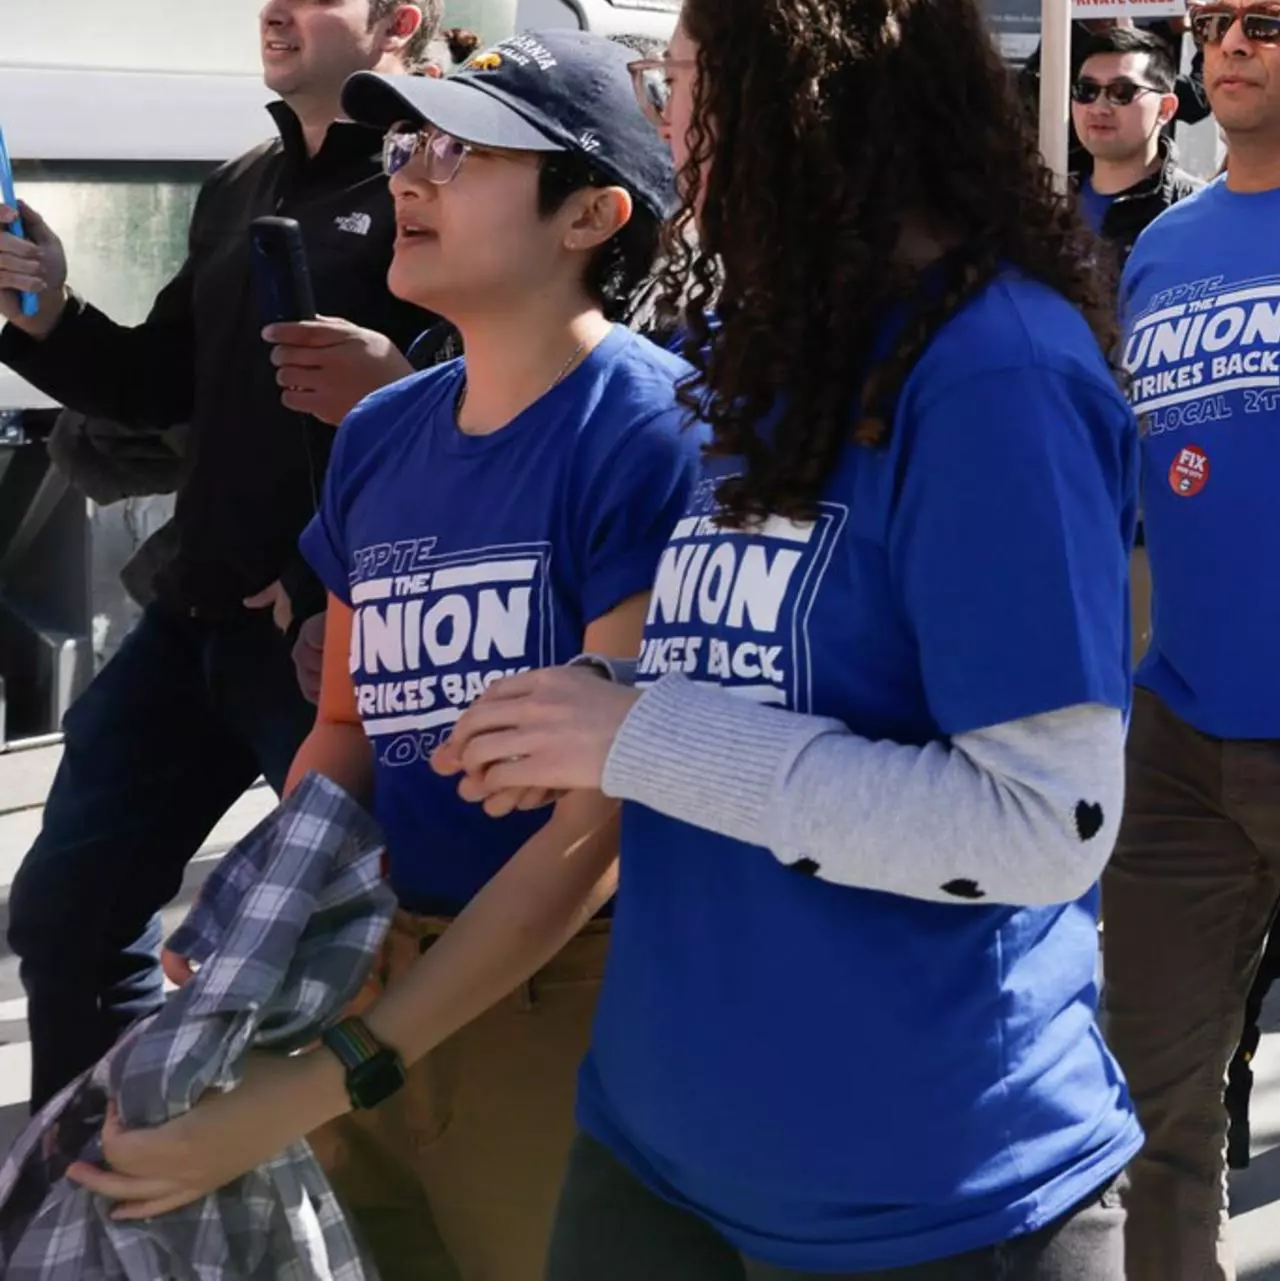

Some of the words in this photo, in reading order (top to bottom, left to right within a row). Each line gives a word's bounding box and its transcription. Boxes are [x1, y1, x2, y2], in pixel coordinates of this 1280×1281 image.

[1188, 297, 1216, 313] THE
[1212, 350, 1280, 381] BACK
[1150, 395, 1233, 436] LOCAL
[1244, 390, 1277, 414] 21
[1180, 449, 1207, 472] FIX
[394, 573, 430, 596] THE
[646, 542, 802, 632] NION
